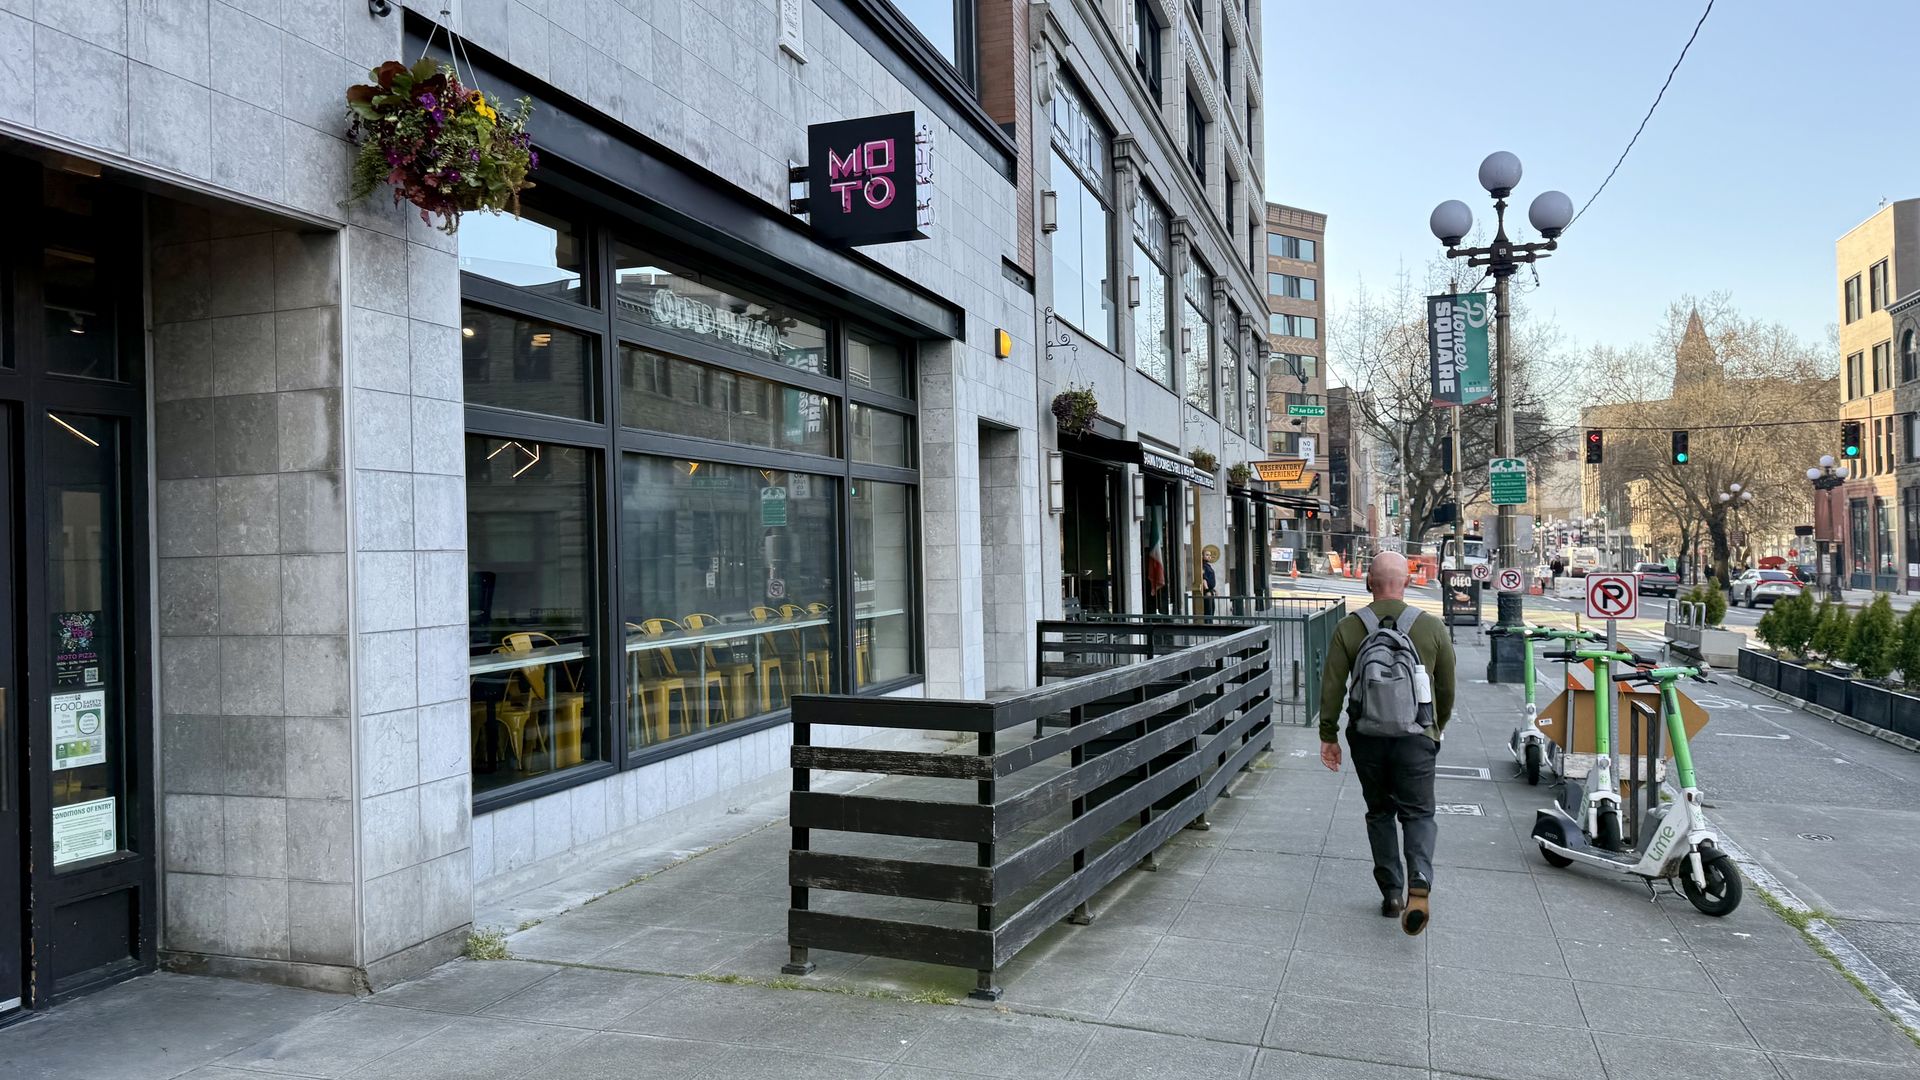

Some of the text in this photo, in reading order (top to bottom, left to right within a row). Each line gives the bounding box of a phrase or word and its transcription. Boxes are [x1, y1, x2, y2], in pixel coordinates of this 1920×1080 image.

[1452, 299, 1488, 374] Pioneer
[1433, 301, 1456, 394] SQUARE
[1260, 463, 1301, 472] OBSERVATORY
[1262, 470, 1299, 479] EXPERIENCE
[57, 652, 97, 661] MOTO PIZZA
[54, 701, 83, 712] FOOD
[94, 802, 112, 812] ENTRY
